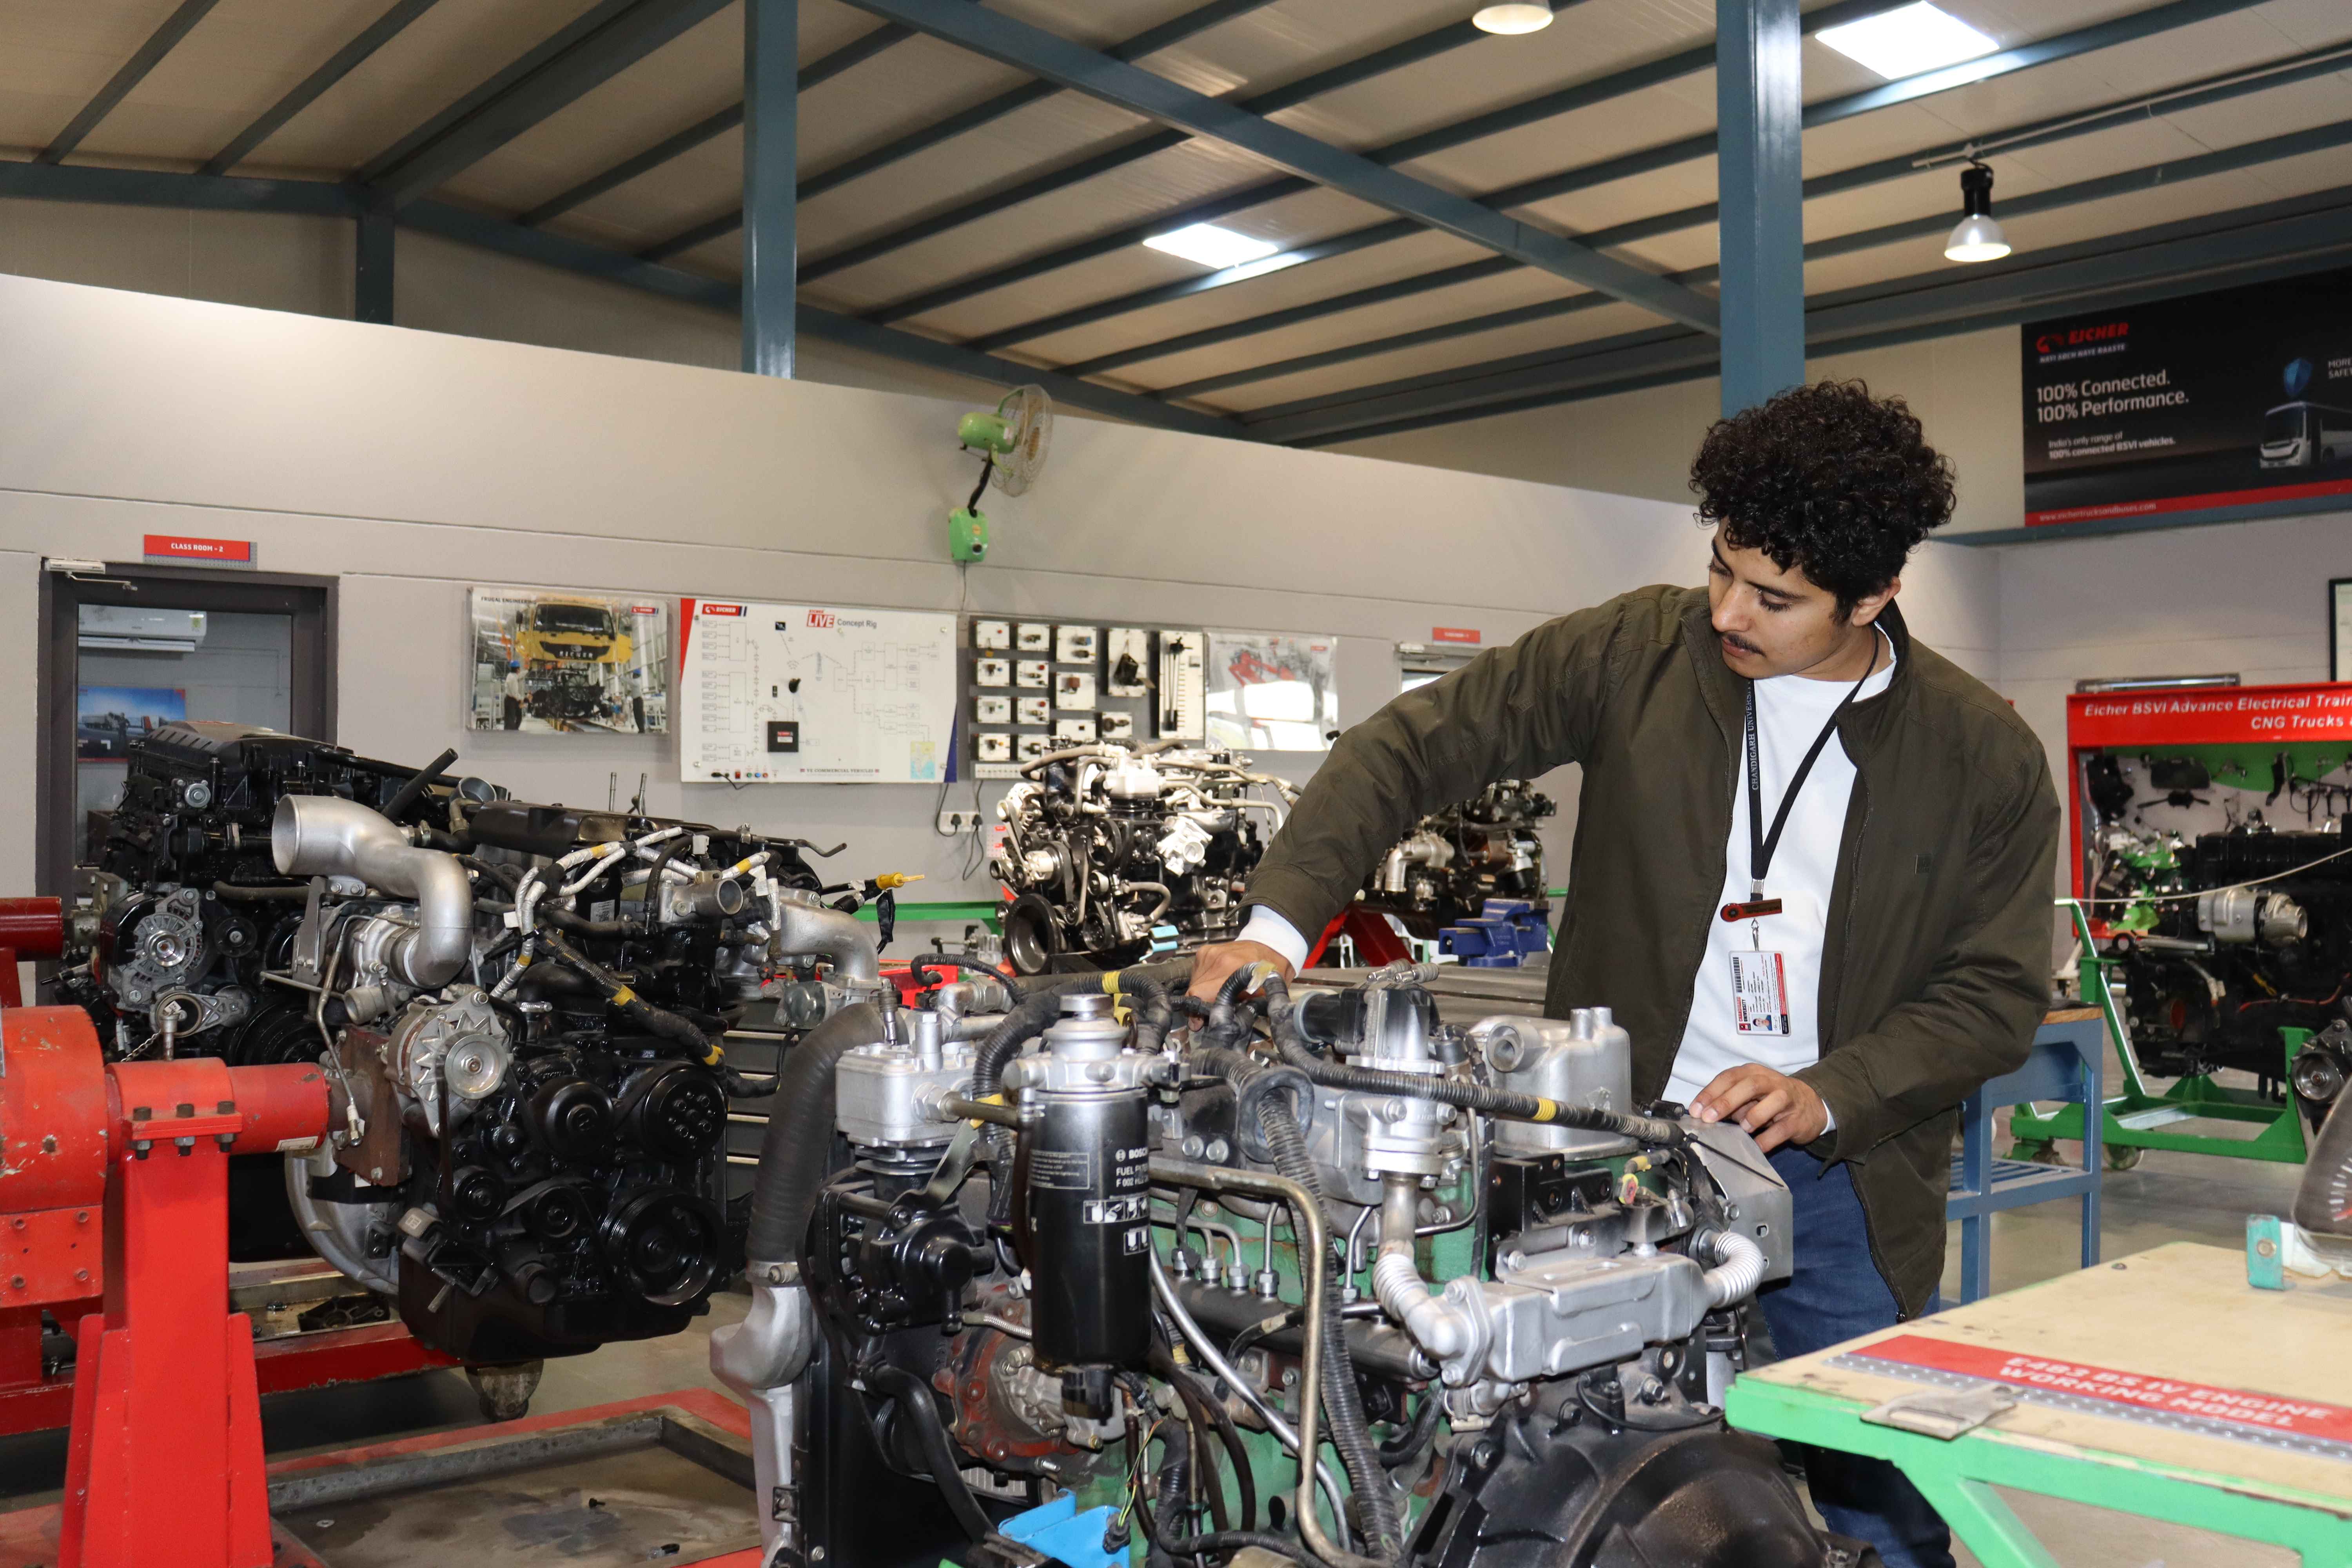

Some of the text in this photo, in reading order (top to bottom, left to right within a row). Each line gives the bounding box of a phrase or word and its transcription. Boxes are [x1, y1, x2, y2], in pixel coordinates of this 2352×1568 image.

[2069, 322, 2129, 345] EICHER
[2037, 369, 2171, 403] 100% Connected.
[2037, 390, 2189, 423] 100% Performance.
[2048, 431, 2123, 449] India's only range of
[2049, 449, 2071, 459] 100%
[2073, 443, 2115, 456] connected
[808, 614, 835, 628] LIVE
[837, 619, 877, 629] Concept Rig
[1746, 681, 1755, 731] UNIVERS
[2084, 704, 2129, 717] Eicher
[2132, 702, 2167, 715] BSVI
[2170, 700, 2233, 713] Advance
[2238, 695, 2311, 711] Electrical
[2251, 715, 2286, 730] CNG
[2292, 714, 2344, 729] Trucks
[1748, 733, 1759, 790] CHANDIGARH
[1116, 1166, 1134, 1176] FUEL
[1116, 1178, 1121, 1187] F
[2000, 1366, 2293, 1427] WORKING MODEL
[2006, 1357, 2333, 1420] E483 BS IV ENGINE
